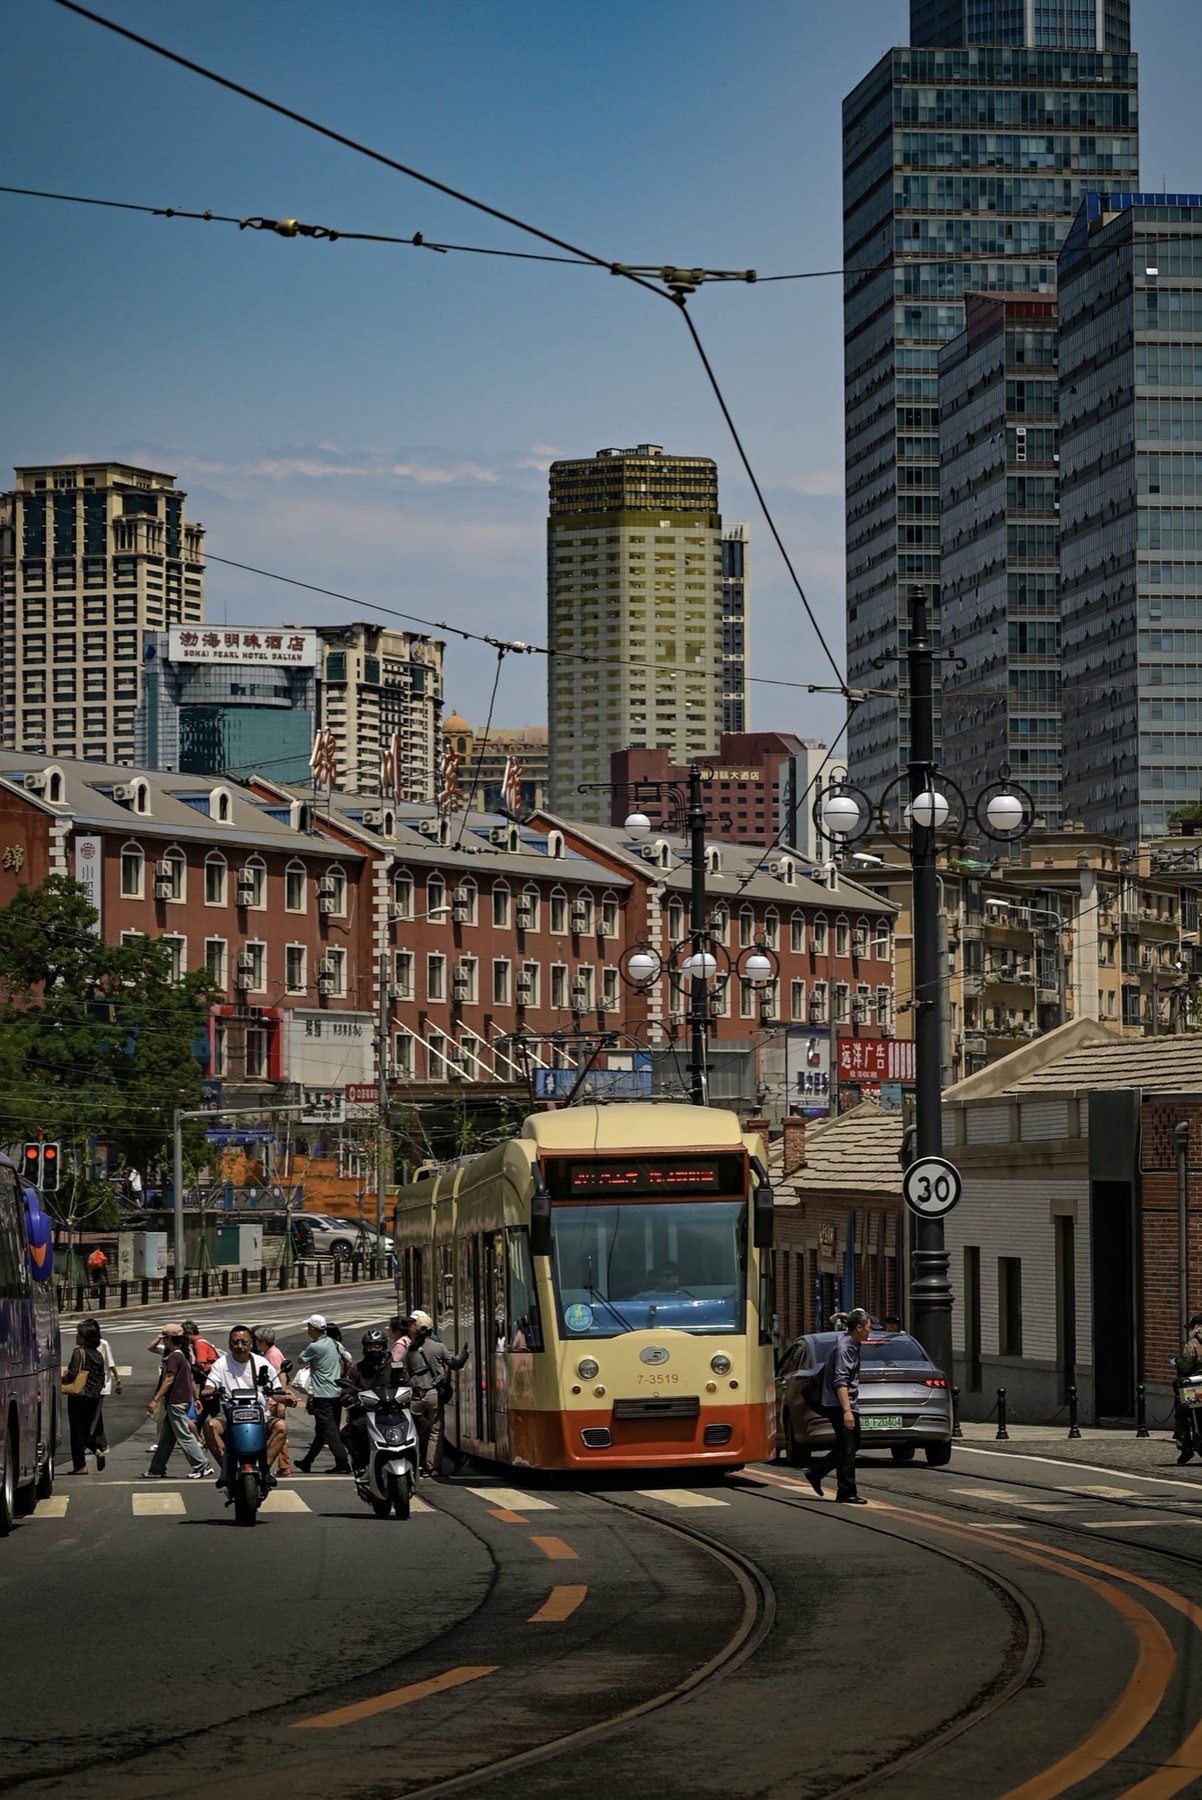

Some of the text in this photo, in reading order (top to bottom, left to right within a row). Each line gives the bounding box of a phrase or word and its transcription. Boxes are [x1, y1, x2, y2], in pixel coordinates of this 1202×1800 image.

[179, 631, 306, 652] 渤海明珠酒店
[213, 651, 239, 659] PEARL
[242, 652, 268, 660] HOTEL
[272, 653, 302, 661] DALIAN
[841, 1042, 885, 1068] 远洋广告
[917, 1176, 950, 1203] 30
[637, 1374, 679, 1385] 7-3519
